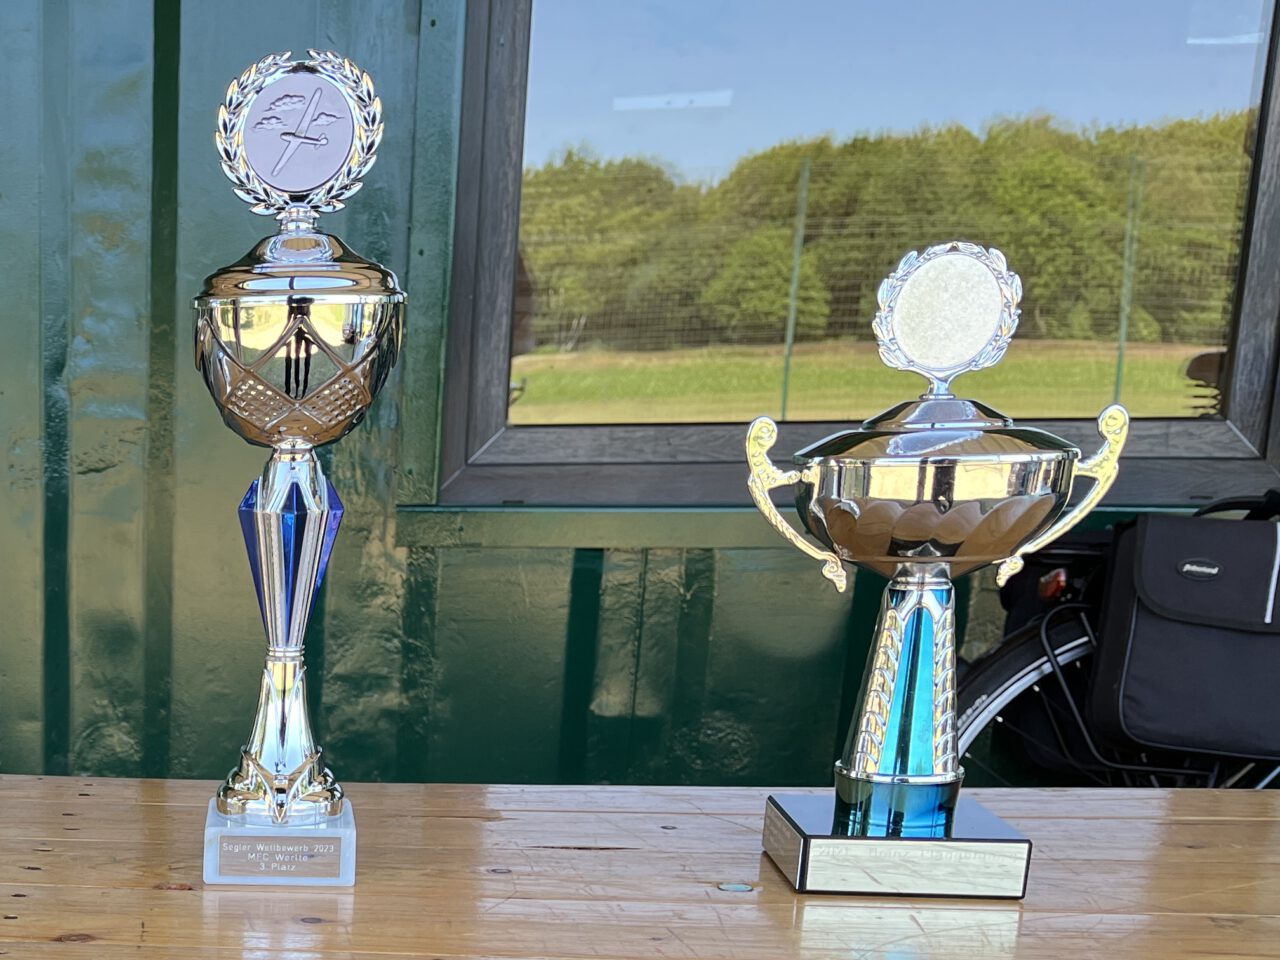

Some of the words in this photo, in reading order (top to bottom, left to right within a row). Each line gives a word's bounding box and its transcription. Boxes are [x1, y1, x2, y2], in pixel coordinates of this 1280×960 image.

[222, 842, 251, 853] Segler
[256, 843, 309, 853] Wettbewerb
[313, 844, 334, 853] 2023
[247, 852, 269, 861] MFC
[271, 862, 296, 871] Platz
